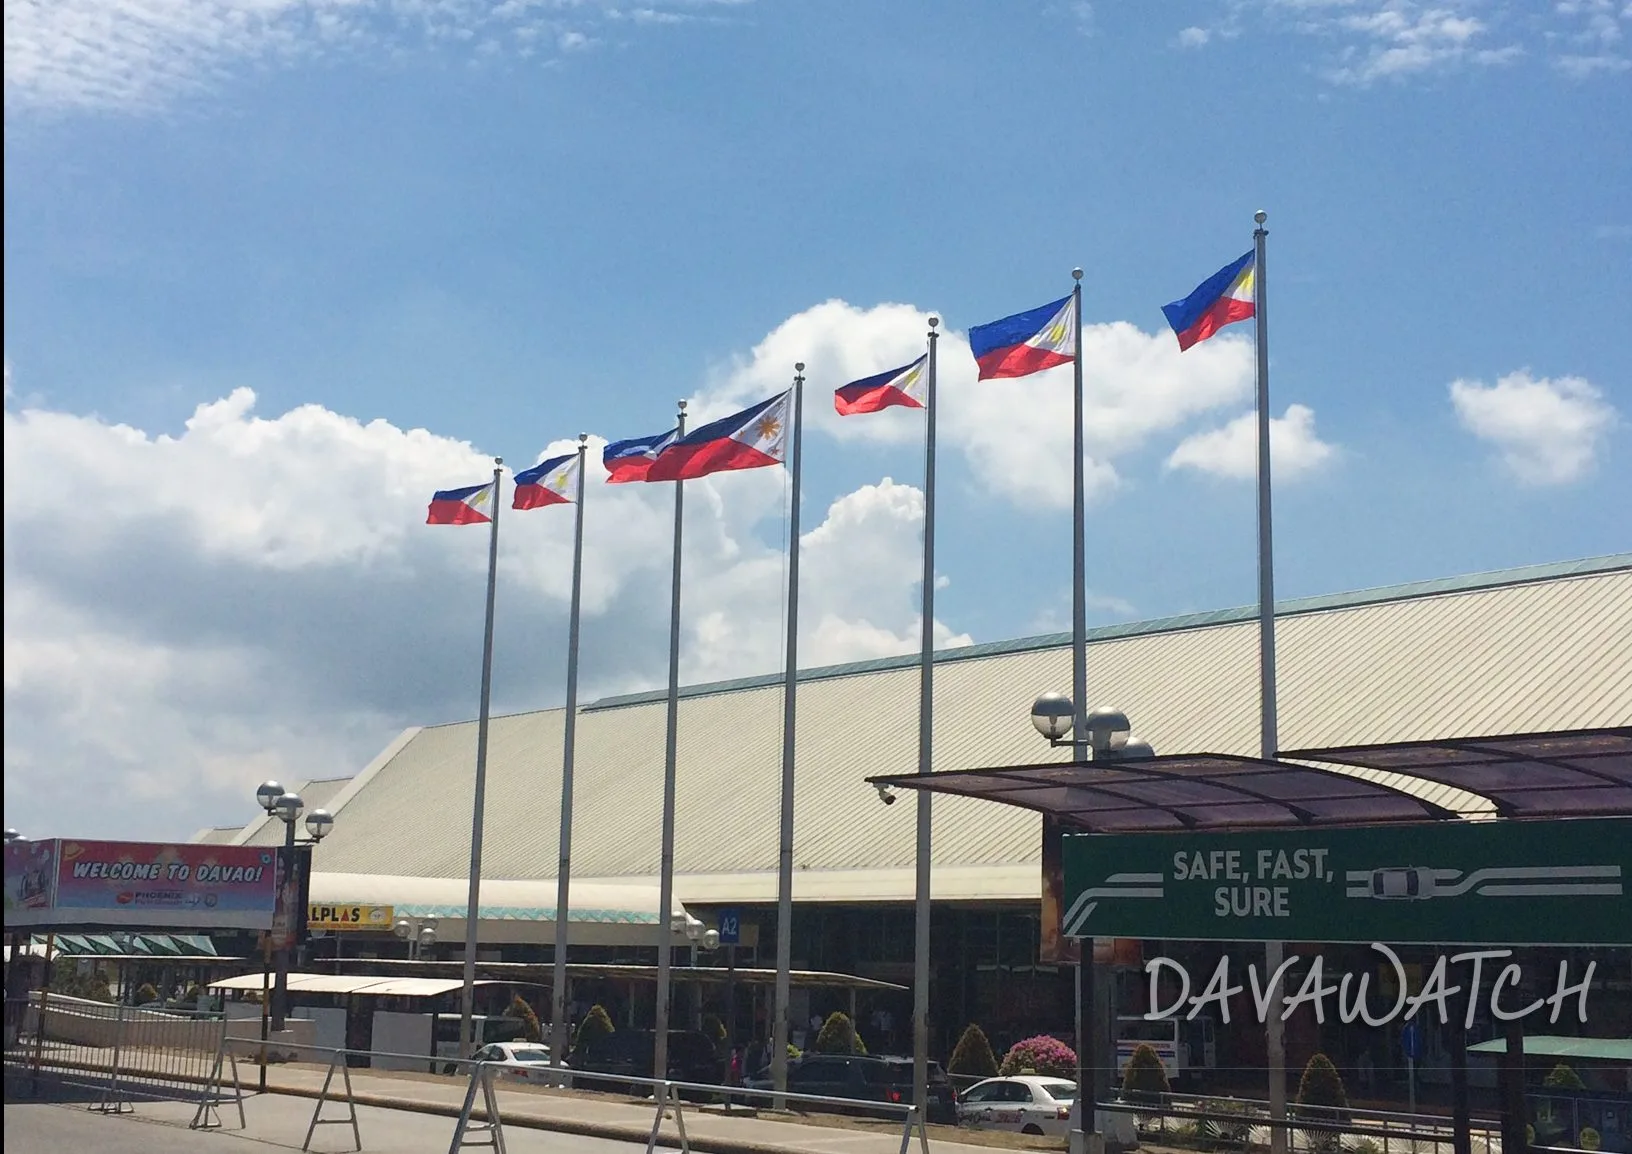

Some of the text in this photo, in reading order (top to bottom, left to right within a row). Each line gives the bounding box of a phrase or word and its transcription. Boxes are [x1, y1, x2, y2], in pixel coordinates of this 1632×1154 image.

[73, 862, 262, 882] WELCOME TO DAVAO!
[1173, 848, 1333, 883] SAFE, FAST,
[1214, 886, 1290, 917] SURE
[308, 907, 360, 922] LPLAS
[722, 917, 737, 935] A2
